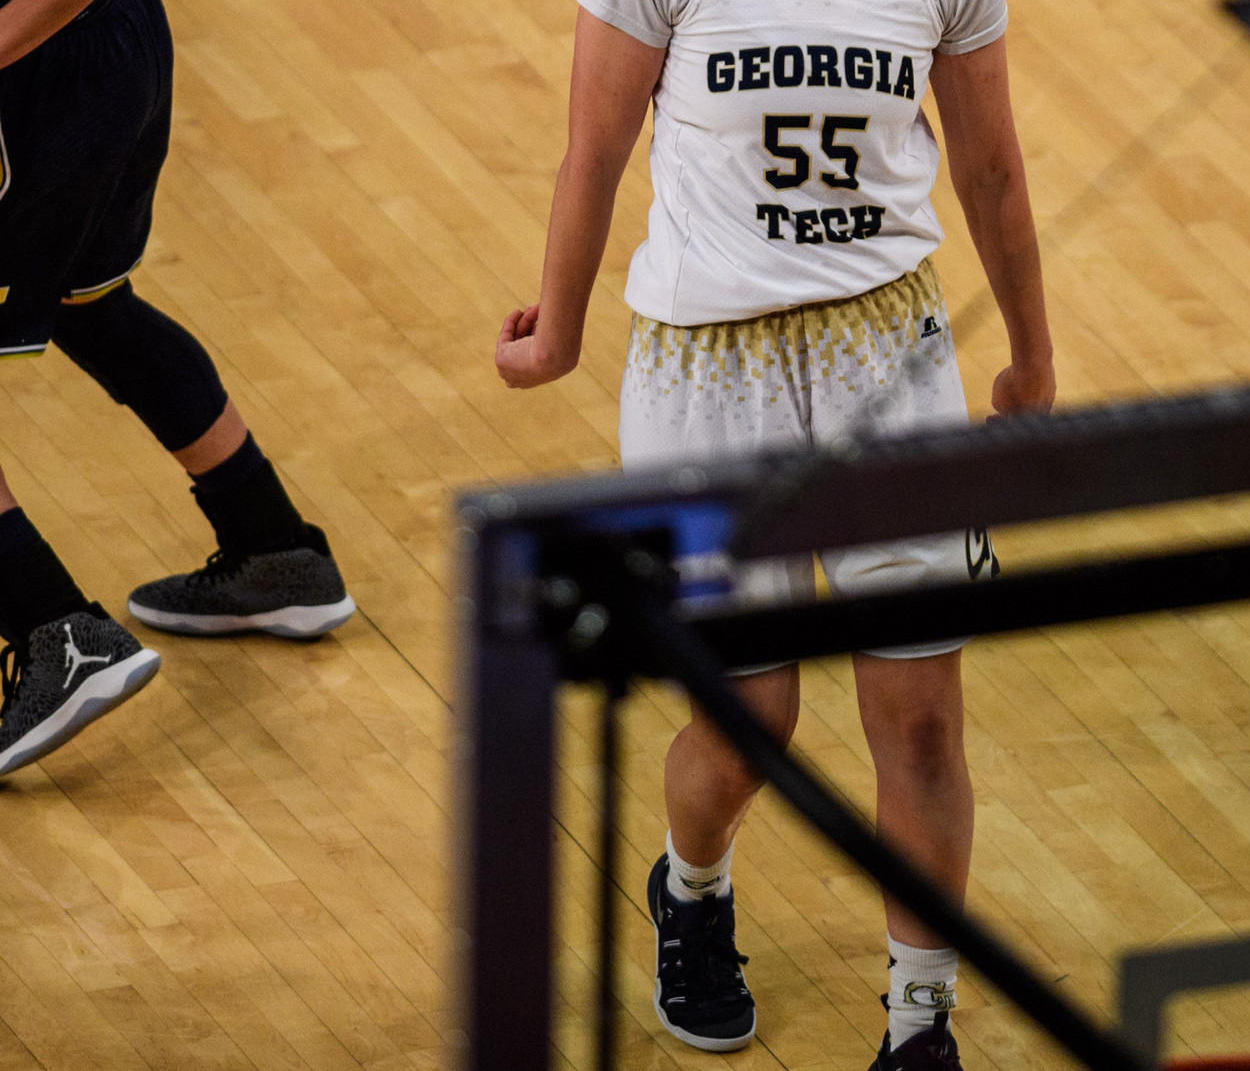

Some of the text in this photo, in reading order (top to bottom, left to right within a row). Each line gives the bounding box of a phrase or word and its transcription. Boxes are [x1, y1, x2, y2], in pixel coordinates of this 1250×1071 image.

[707, 45, 915, 100] GEORGIA
[762, 113, 871, 192] 55
[756, 203, 886, 244] TECH
